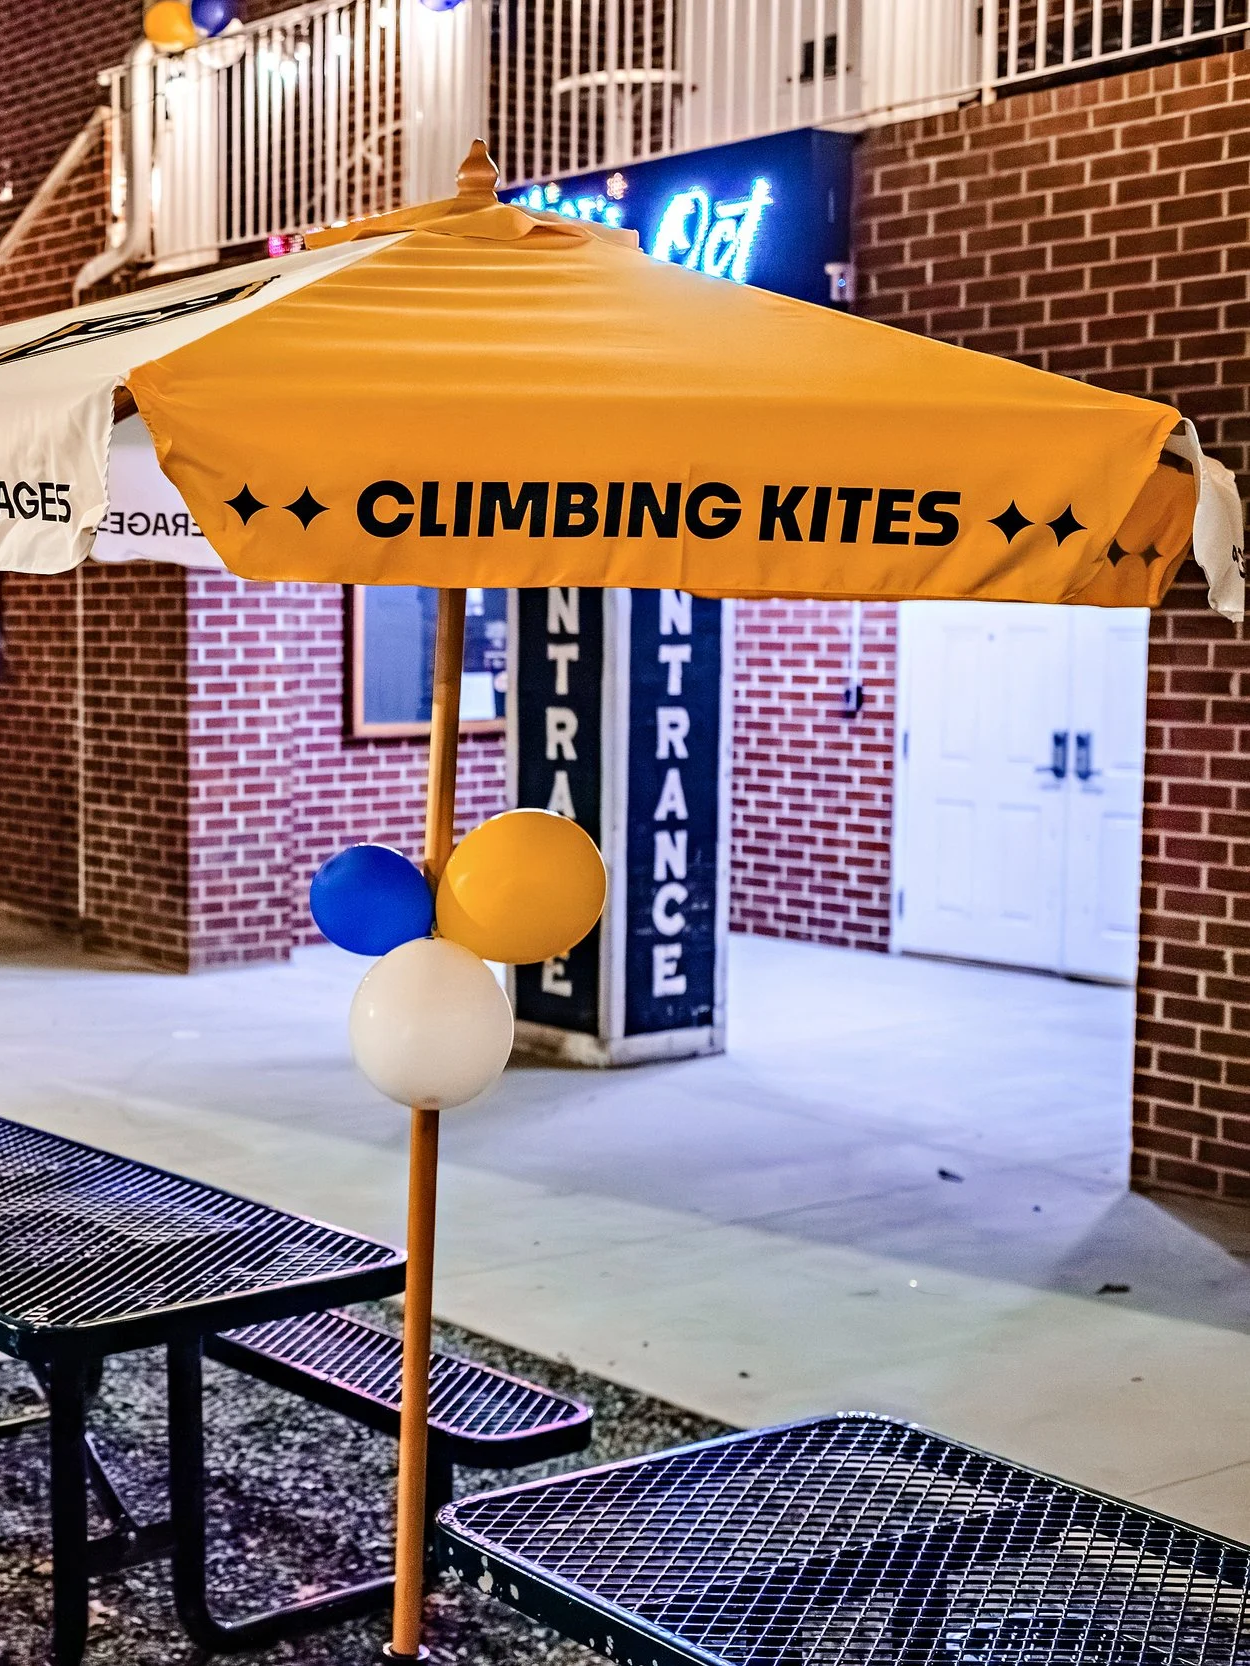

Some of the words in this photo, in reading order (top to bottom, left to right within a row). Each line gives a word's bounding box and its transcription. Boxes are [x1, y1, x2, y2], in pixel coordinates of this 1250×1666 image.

[356, 479, 742, 540] CLIMBING
[758, 485, 962, 547] KITES
[542, 587, 580, 998] NTRAE
[652, 588, 693, 998] NTRANCE
